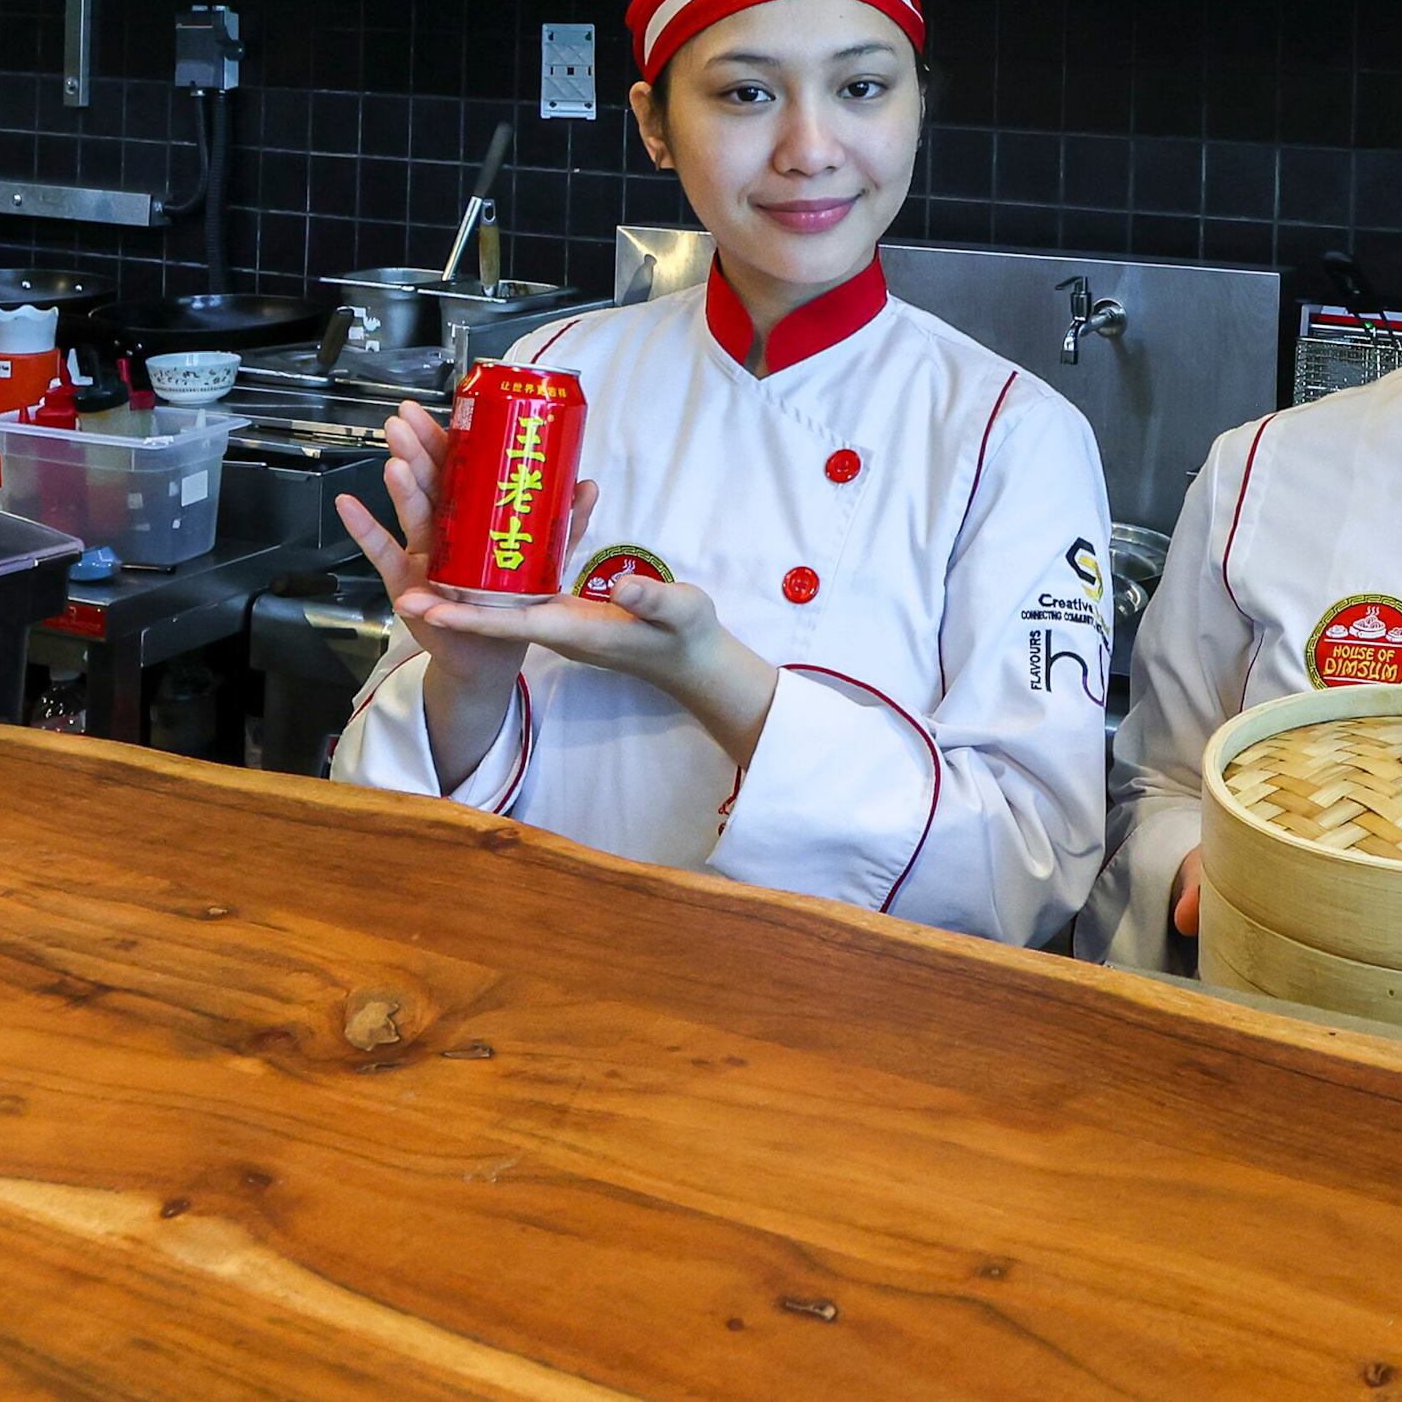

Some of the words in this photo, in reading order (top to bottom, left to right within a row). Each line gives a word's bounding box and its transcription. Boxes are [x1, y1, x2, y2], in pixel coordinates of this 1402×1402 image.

[489, 416, 546, 571] 王老吉
[1029, 629, 1042, 691] FLAVOURS
[1323, 658, 1399, 682] DIMSUM
[1333, 645, 1375, 661] HOUSE
[1377, 648, 1396, 663] OF
